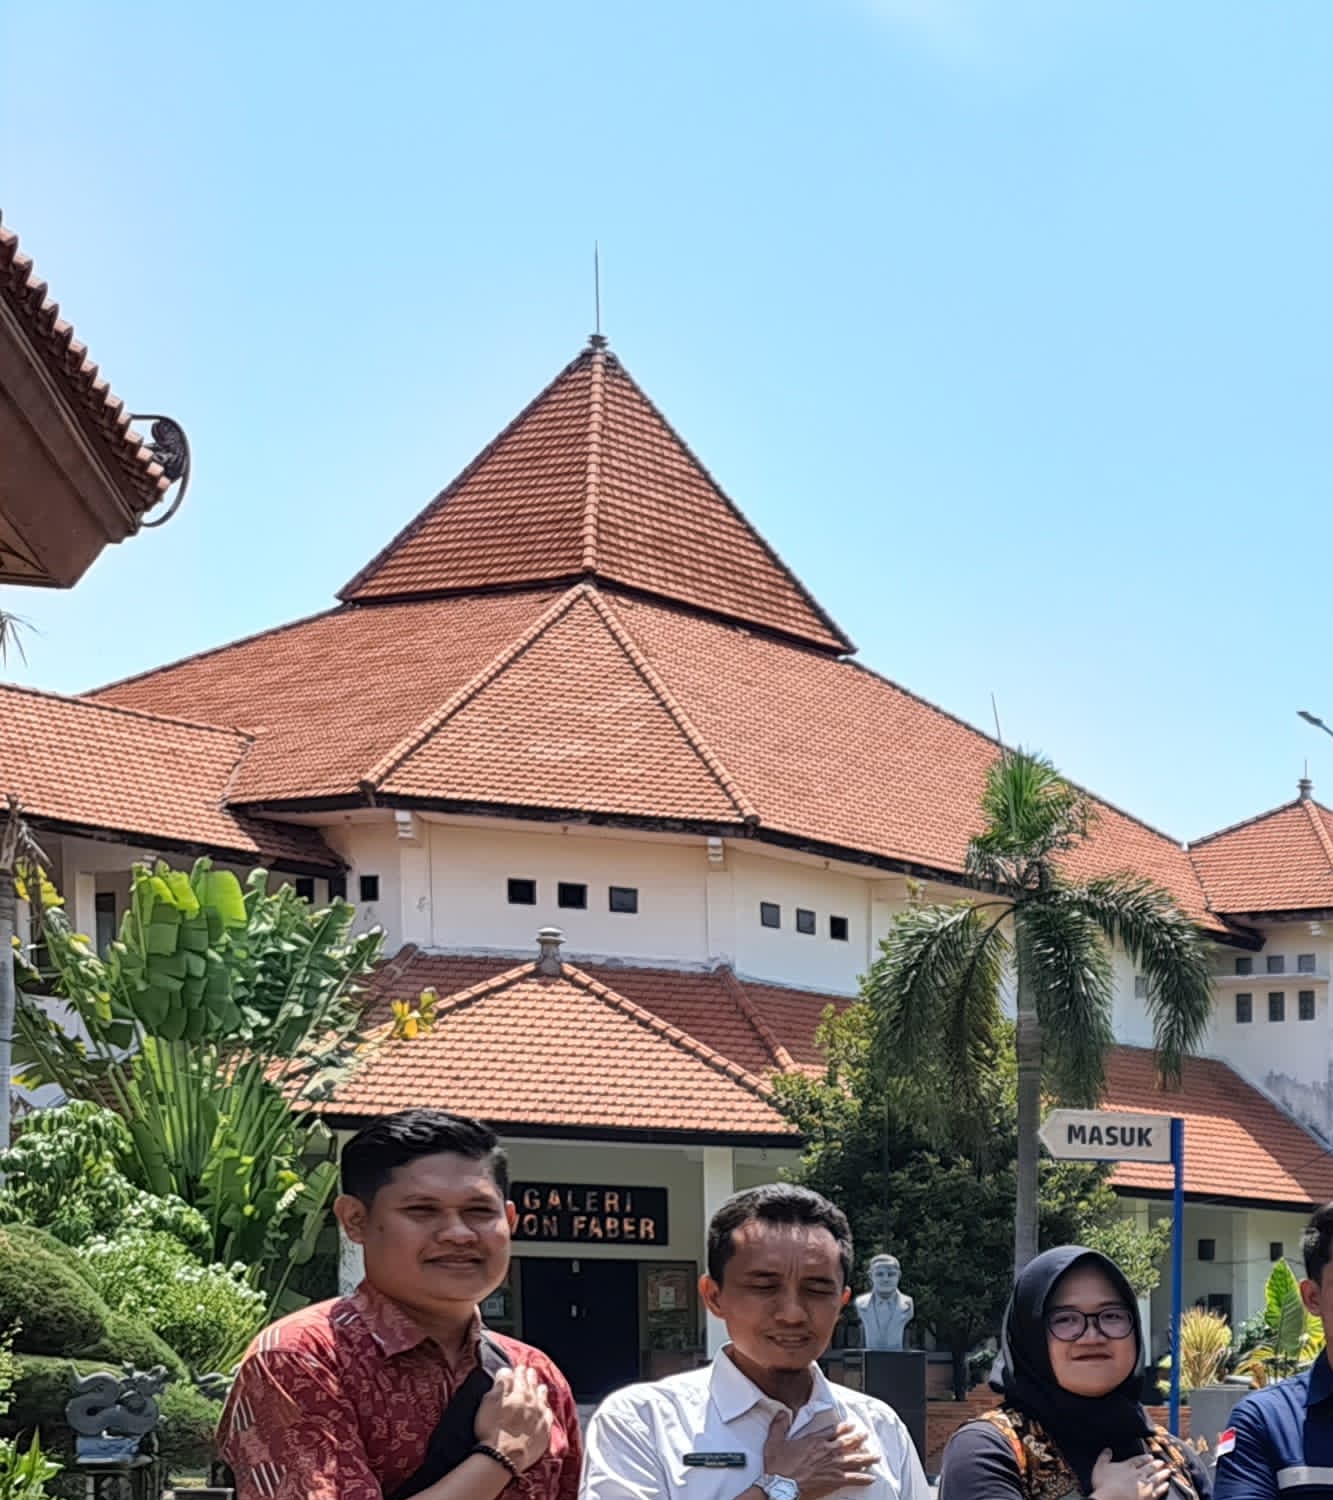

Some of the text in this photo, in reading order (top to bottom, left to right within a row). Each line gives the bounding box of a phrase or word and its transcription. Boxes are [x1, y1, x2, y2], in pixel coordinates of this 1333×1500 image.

[1067, 1123, 1153, 1147] MASUK
[522, 1187, 632, 1213] GALERI
[572, 1215, 656, 1240] FABER
